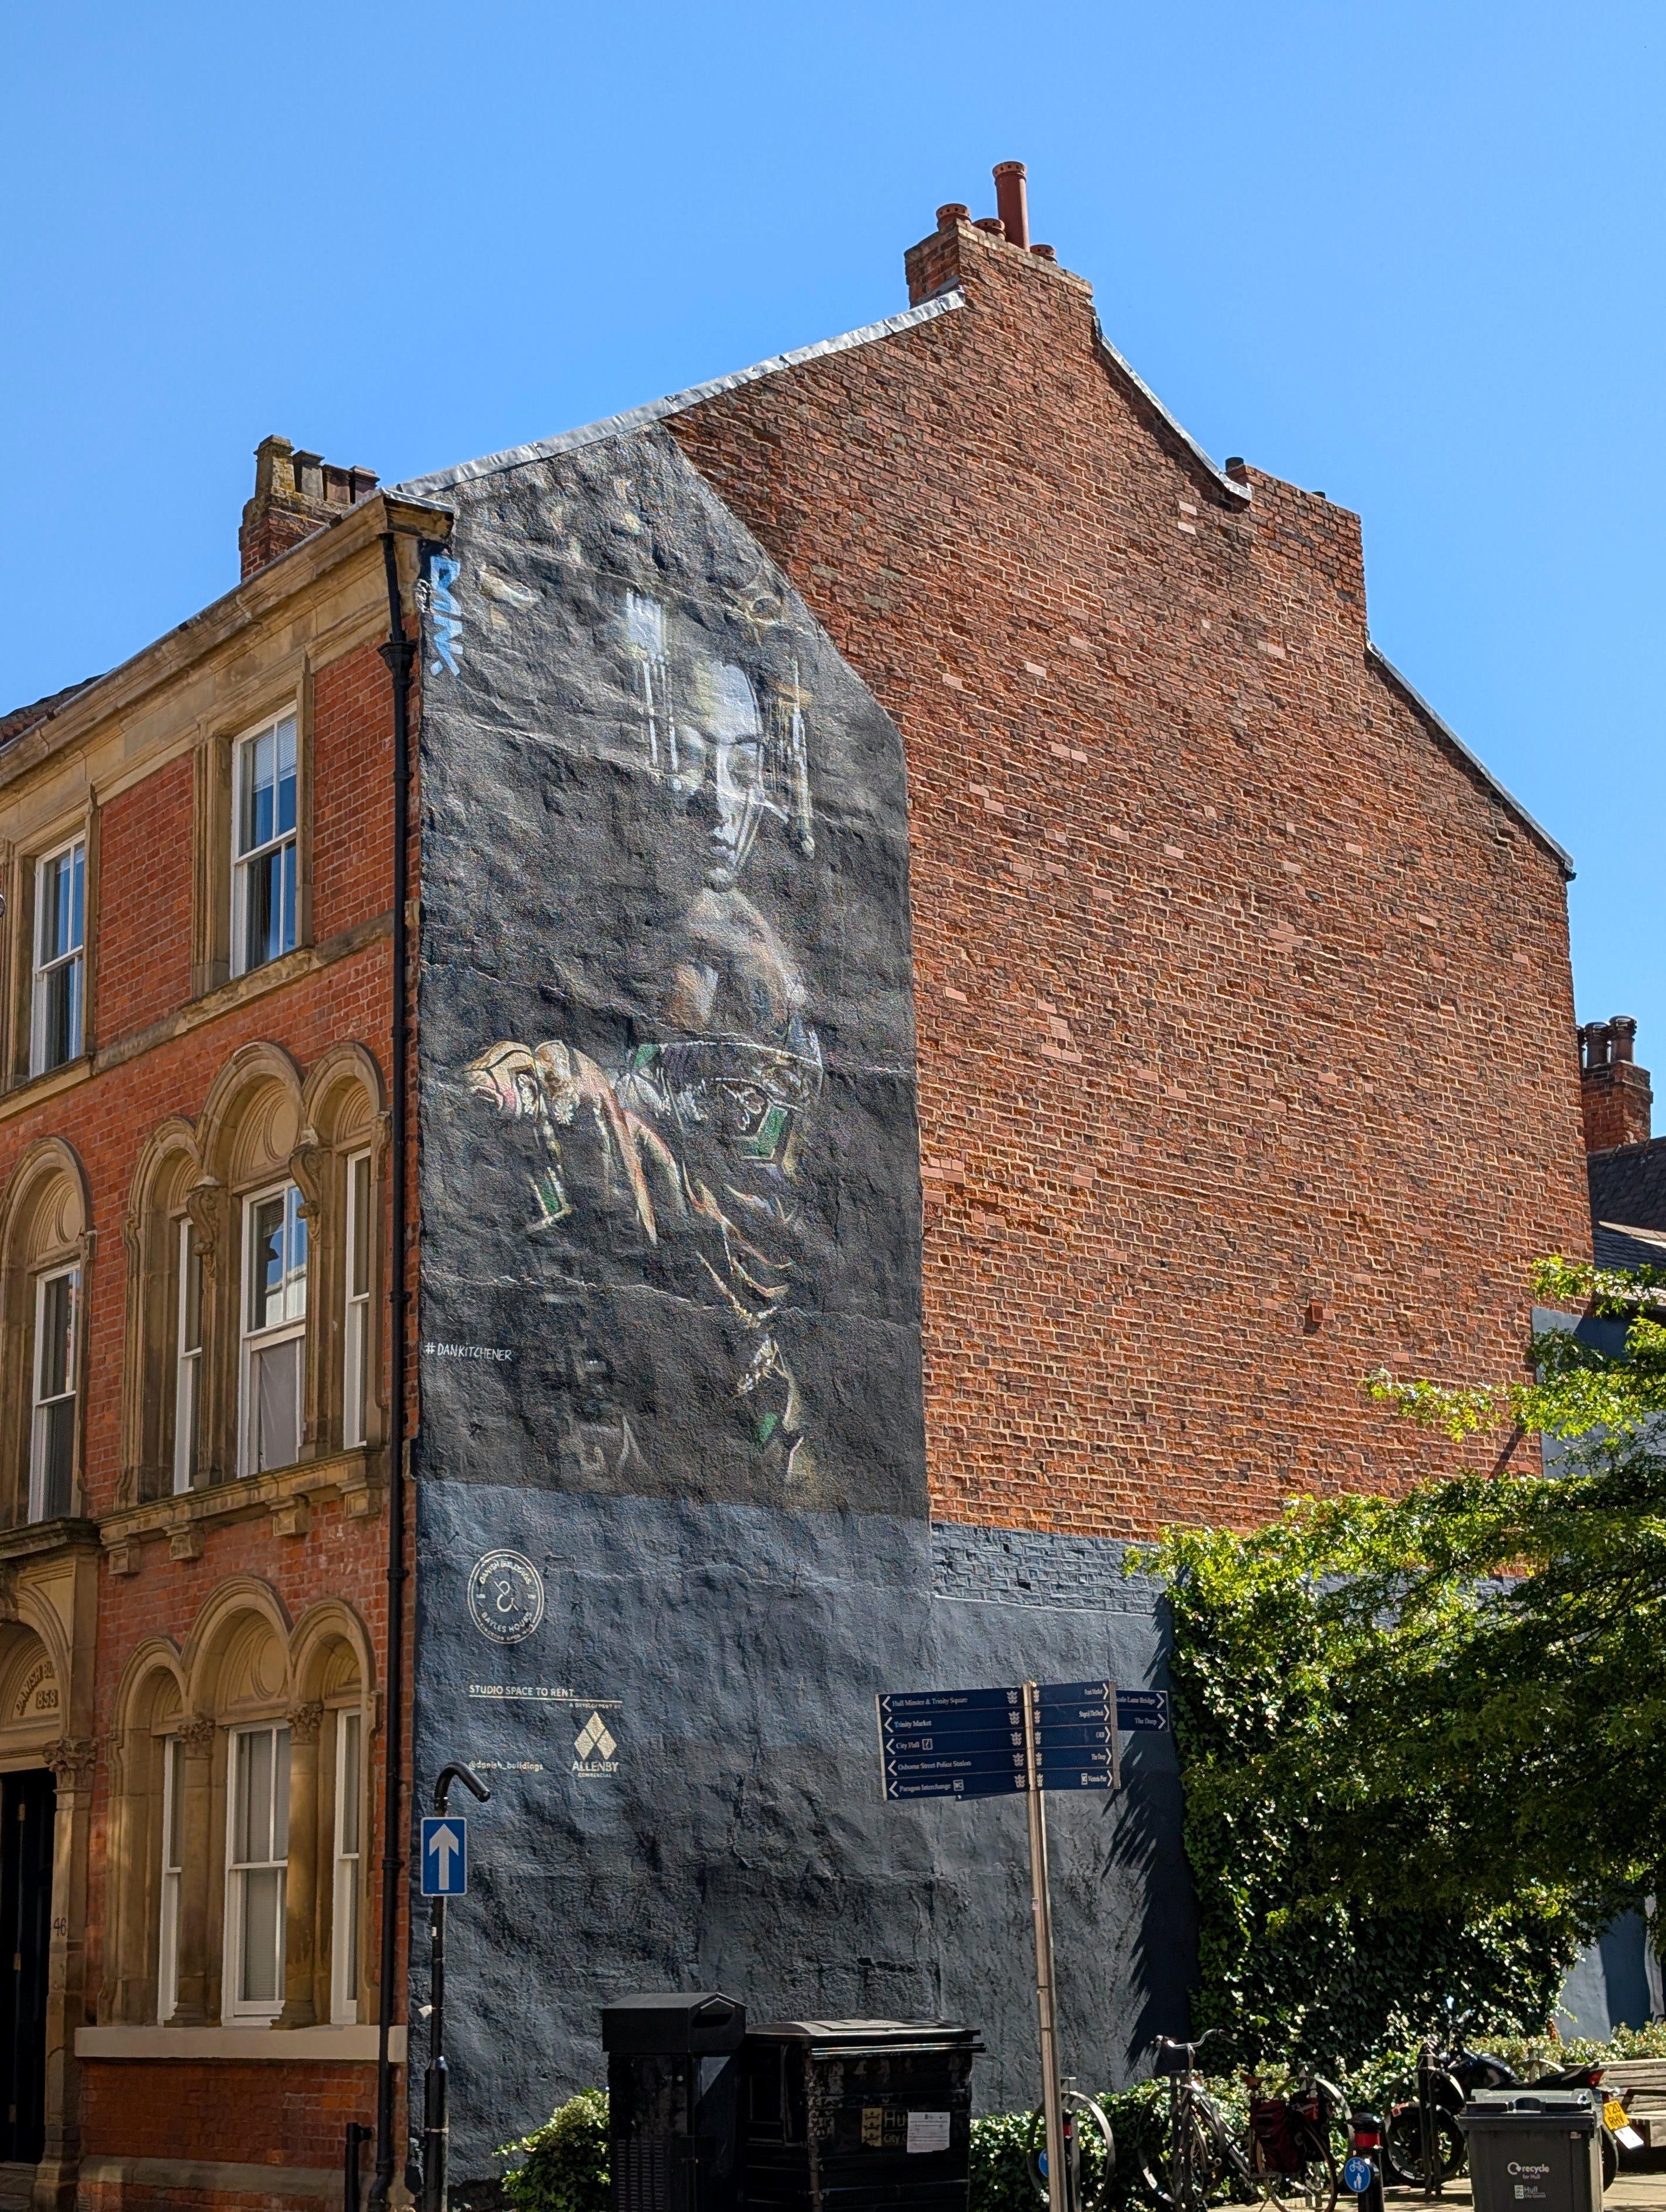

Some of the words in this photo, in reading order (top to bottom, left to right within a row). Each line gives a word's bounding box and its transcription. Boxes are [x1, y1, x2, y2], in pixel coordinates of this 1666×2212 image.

[482, 1611, 507, 1633] BAYLES
[15, 1664, 43, 1716] DANISH
[469, 1684, 503, 1695] STUDIO
[505, 1686, 533, 1696] SPACE
[535, 1687, 548, 1697] TO
[550, 1688, 574, 1697] RENT
[1144, 1718, 1157, 1726] Deep
[572, 1760, 619, 1773] ALLENBY
[53, 1917, 67, 1937] 46
[1604, 2102, 1620, 2114] Y20
[1608, 2114, 1624, 2126] RHV
[1522, 2164, 1549, 2174] recycle
